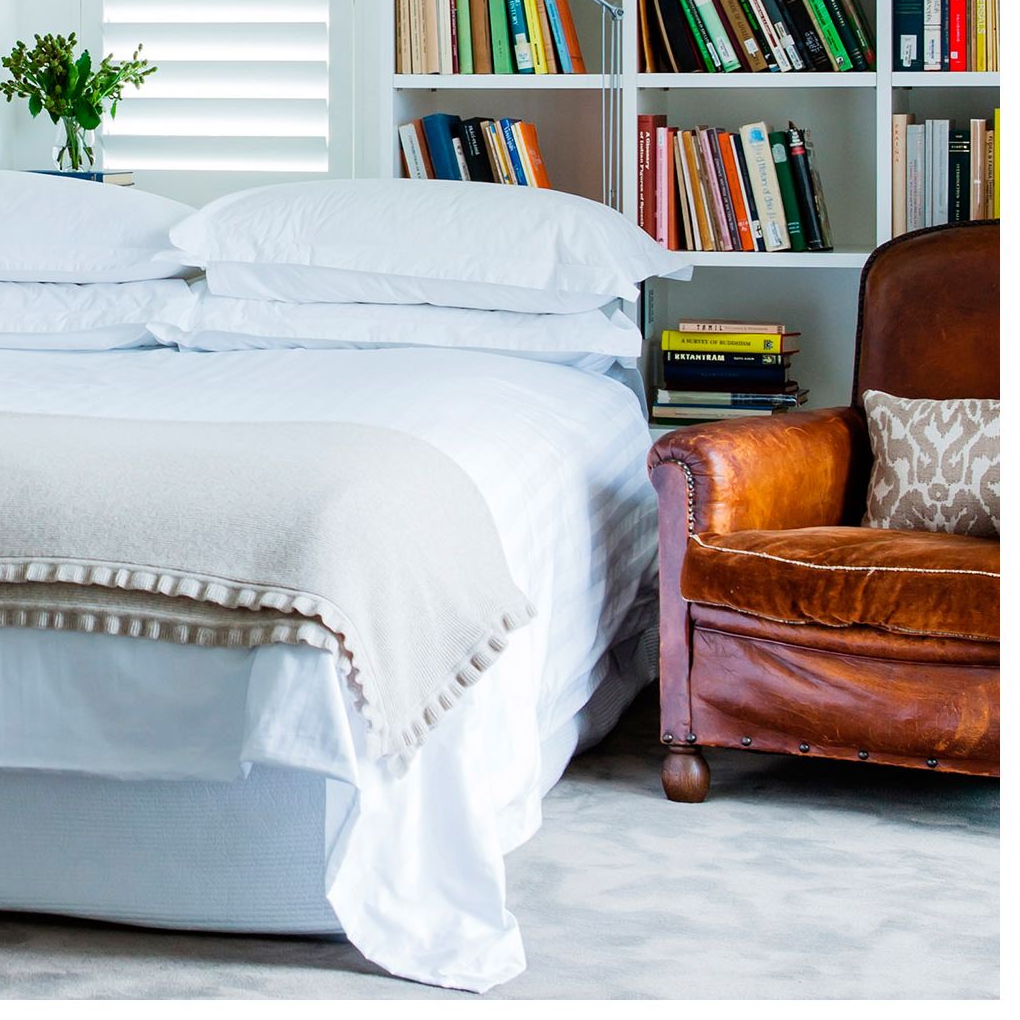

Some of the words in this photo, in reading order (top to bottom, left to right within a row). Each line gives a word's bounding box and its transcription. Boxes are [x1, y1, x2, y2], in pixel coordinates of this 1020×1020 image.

[643, 138, 651, 171] Glossary
[637, 200, 645, 227] Speech
[719, 339, 752, 347] BUDDHISM
